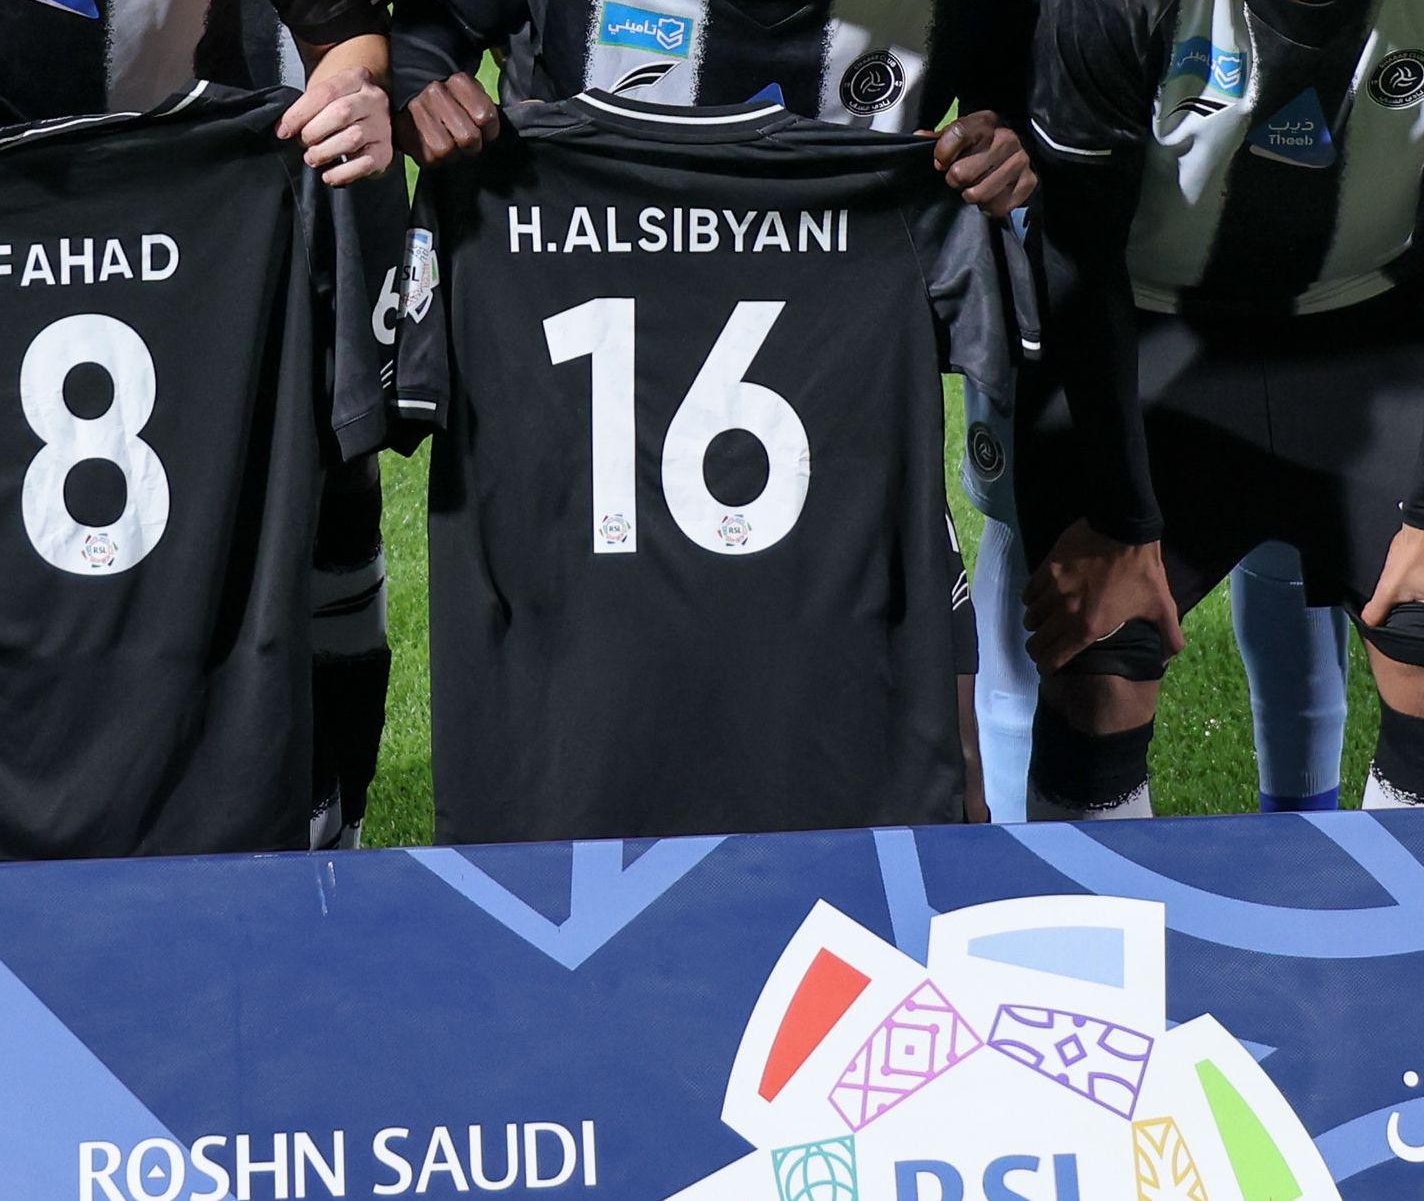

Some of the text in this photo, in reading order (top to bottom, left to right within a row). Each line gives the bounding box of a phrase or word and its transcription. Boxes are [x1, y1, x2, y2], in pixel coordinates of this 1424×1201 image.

[1269, 134, 1313, 146] Theeb
[507, 205, 848, 253] H.ALSIBYANI
[19, 313, 171, 576] 8
[542, 297, 811, 555] 16
[93, 545, 108, 555] RSL
[78, 1120, 598, 1201] ROSHN SAUDI
